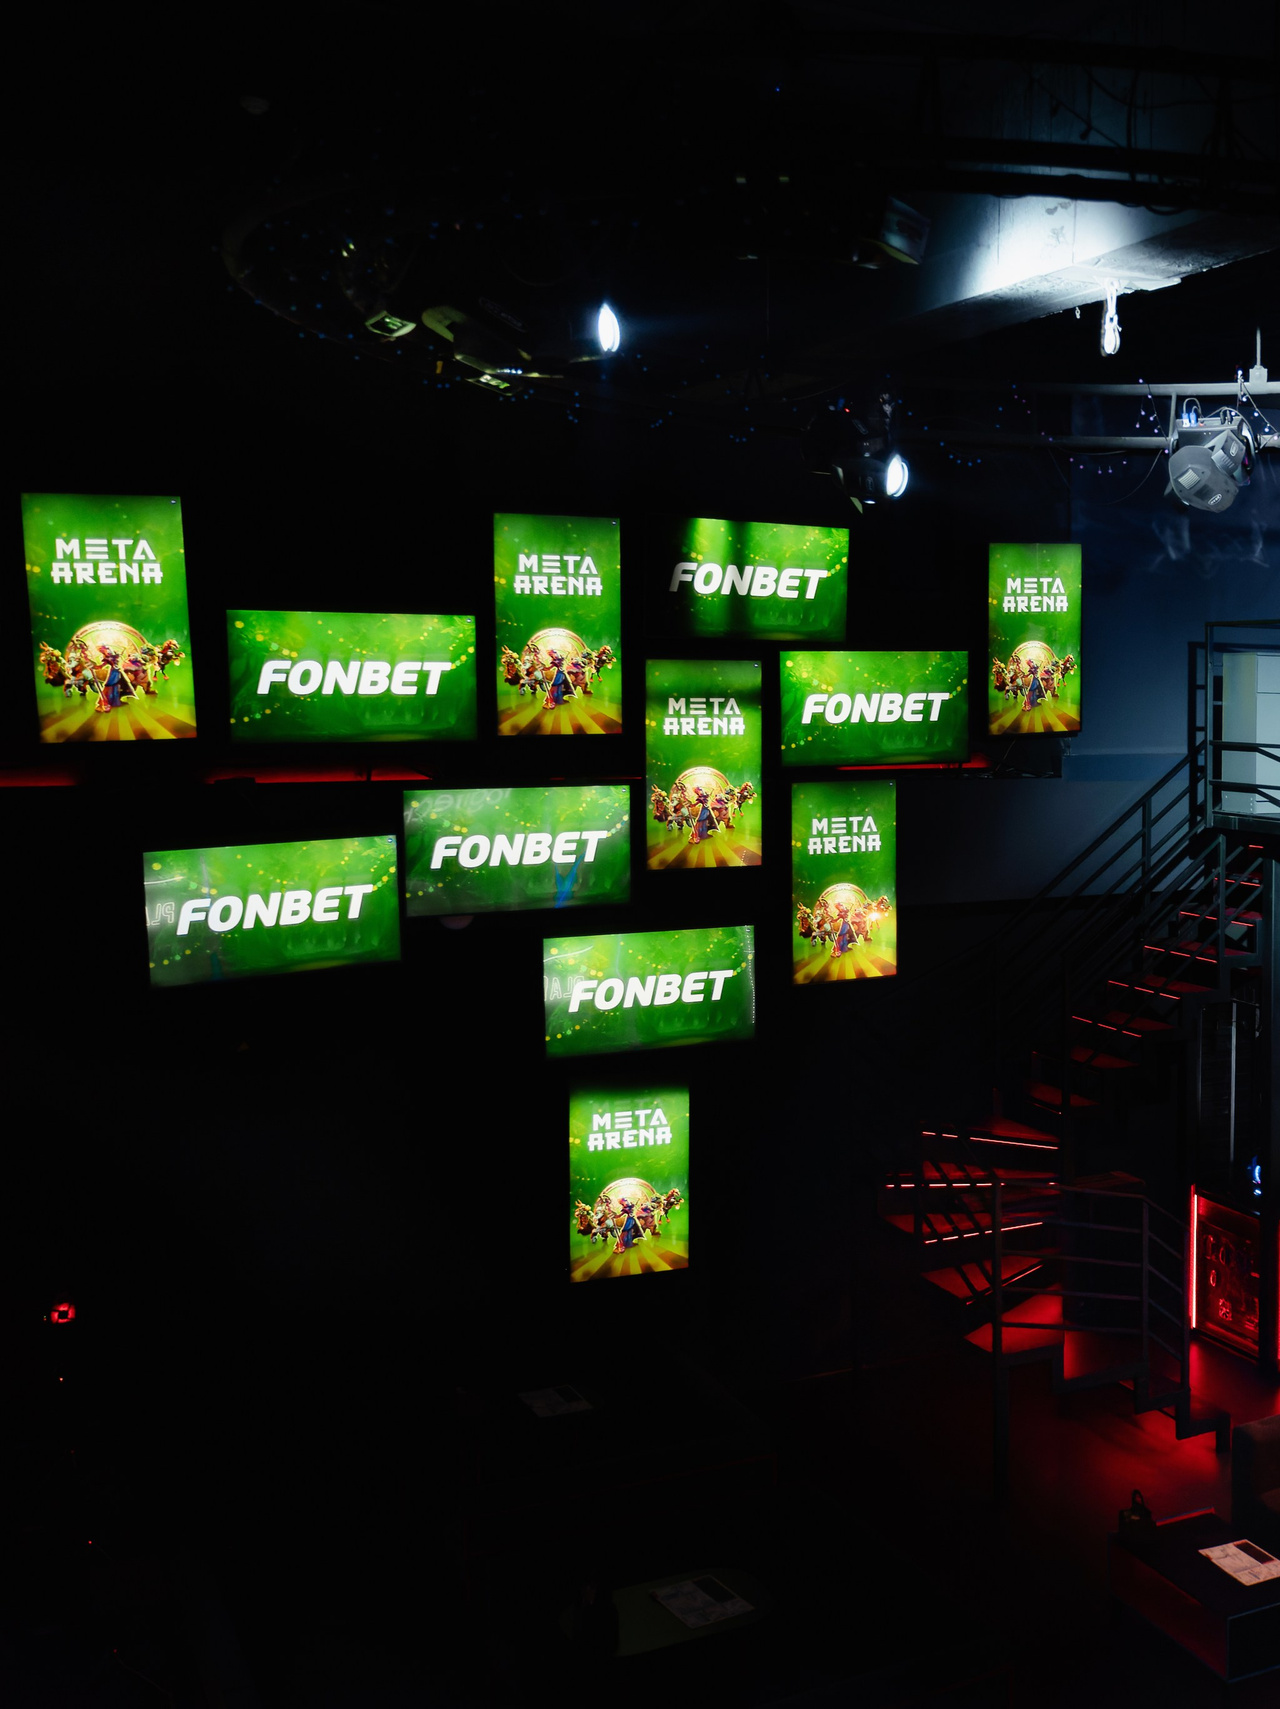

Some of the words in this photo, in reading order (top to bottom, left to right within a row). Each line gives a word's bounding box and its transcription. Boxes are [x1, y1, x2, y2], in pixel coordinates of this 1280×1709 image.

[56, 538, 157, 562] META
[51, 562, 164, 584] ARENA
[518, 554, 599, 575] META
[514, 575, 603, 596] ARENA
[669, 561, 829, 600] FONBET
[1006, 577, 1066, 595] META
[1002, 595, 1069, 613] ARENA
[257, 660, 452, 695] FONBET
[668, 697, 742, 717] META
[802, 693, 949, 725] FONBET
[663, 716, 746, 736] ARENA
[811, 816, 877, 836] META
[430, 830, 609, 870] FONBET
[807, 834, 882, 855] ARENA
[177, 884, 374, 937] FONBET
[568, 970, 734, 1013] FONBET
[592, 1108, 668, 1131] META
[587, 1127, 673, 1152] ARENA
